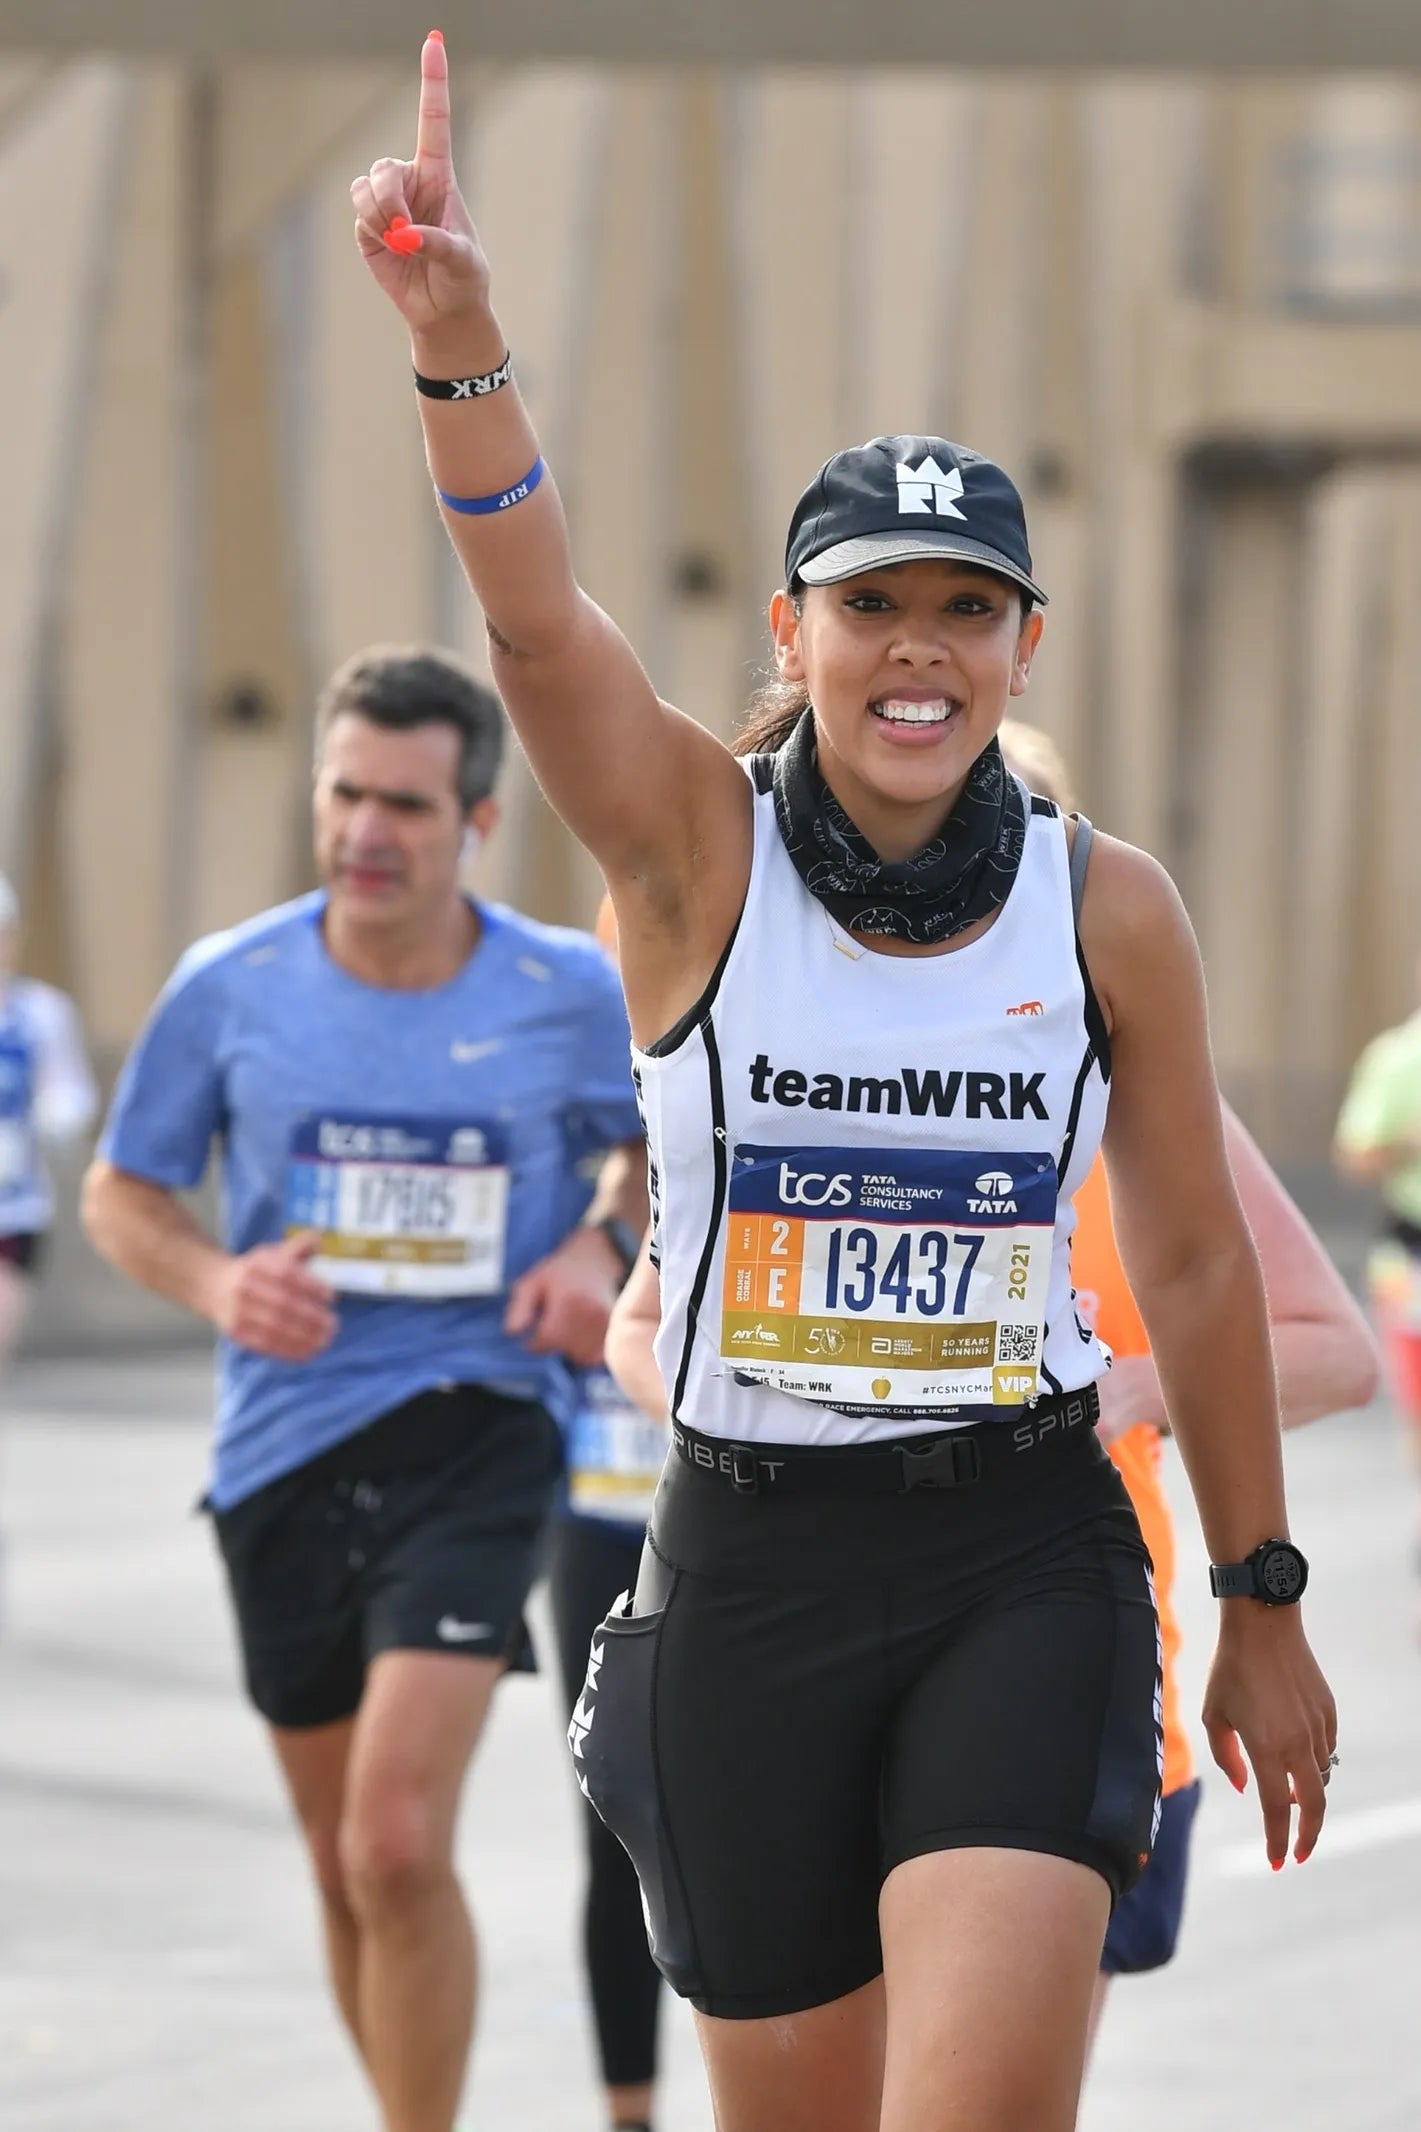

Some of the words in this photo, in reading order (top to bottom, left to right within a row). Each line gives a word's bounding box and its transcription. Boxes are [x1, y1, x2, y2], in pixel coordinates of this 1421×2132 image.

[498, 482, 529, 508] RIP
[749, 1054, 1050, 1121] teamWRK
[778, 1162, 852, 1206] tcs
[862, 1175, 897, 1185] TATA
[860, 1186, 943, 1200] CONSULTANCY
[859, 1197, 912, 1211] SERVICES
[966, 1199, 1018, 1214] TATA
[743, 1228, 751, 1249] WAVE
[770, 1220, 790, 1255] 2
[825, 1227, 985, 1316] 13437
[1008, 1244, 1031, 1300] 2021
[736, 1269, 744, 1302] ORANGE
[743, 1270, 751, 1302] CORRAL
[767, 1268, 787, 1308] E
[941, 1347, 989, 1357] RUNNING
[942, 1339, 956, 1348] 50
[959, 1337, 990, 1347] YEARS
[779, 1379, 806, 1391] Team:
[808, 1381, 832, 1393] WRK
[997, 1376, 1033, 1392] VIP
[825, 1404, 845, 1412] RACE
[846, 1405, 892, 1414] EMERGENCY,
